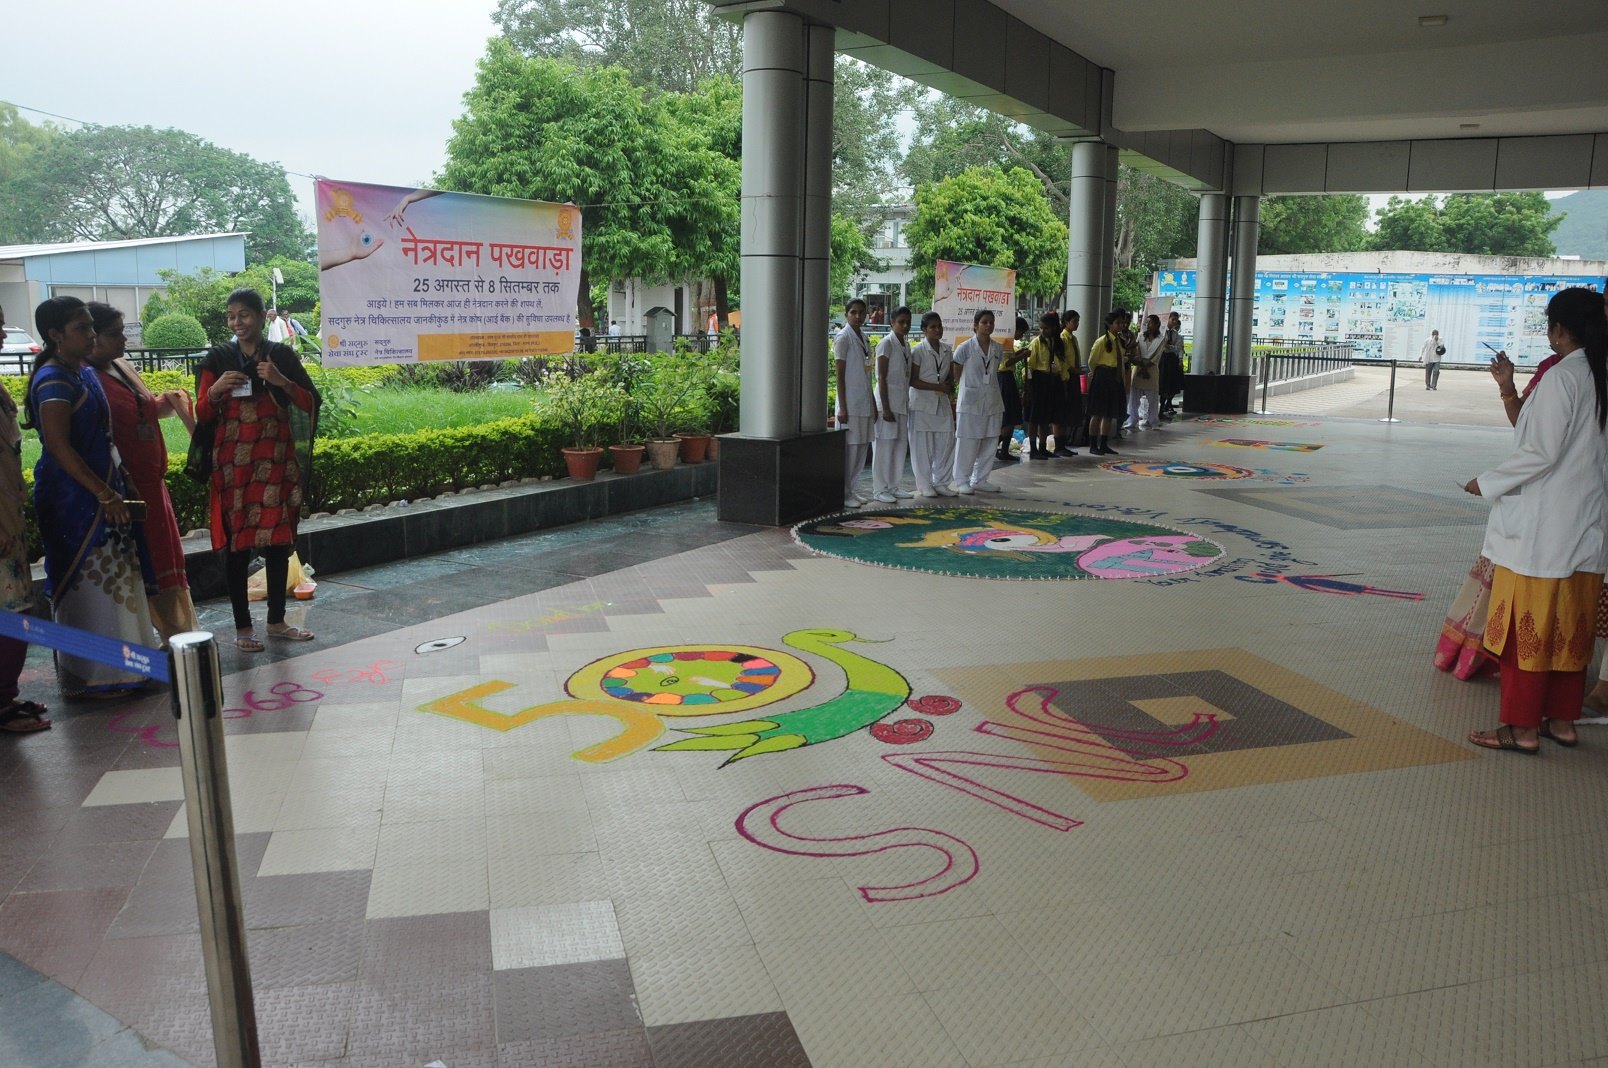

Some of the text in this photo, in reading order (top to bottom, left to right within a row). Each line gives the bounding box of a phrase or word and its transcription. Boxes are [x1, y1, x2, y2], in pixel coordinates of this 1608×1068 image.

[401, 226, 573, 276] नेत्रदान पखवाड़ा
[413, 275, 560, 294] 25 अगस्त से 8 सितम्बर तक
[367, 297, 387, 310] आइये
[394, 299, 405, 309] हम
[407, 300, 418, 308] सब
[420, 298, 445, 309] मिलकर
[447, 300, 461, 308] आज
[464, 298, 470, 309] ही
[472, 298, 493, 309] नेत्रदान
[495, 298, 509, 308] करने
[511, 298, 519, 308] की
[520, 300, 535, 308] शपथ
[354, 314, 366, 325] नेत्र
[368, 313, 411, 325] चिकित्सालय
[457, 313, 467, 324] नेत्र
[517, 313, 524, 322] की
